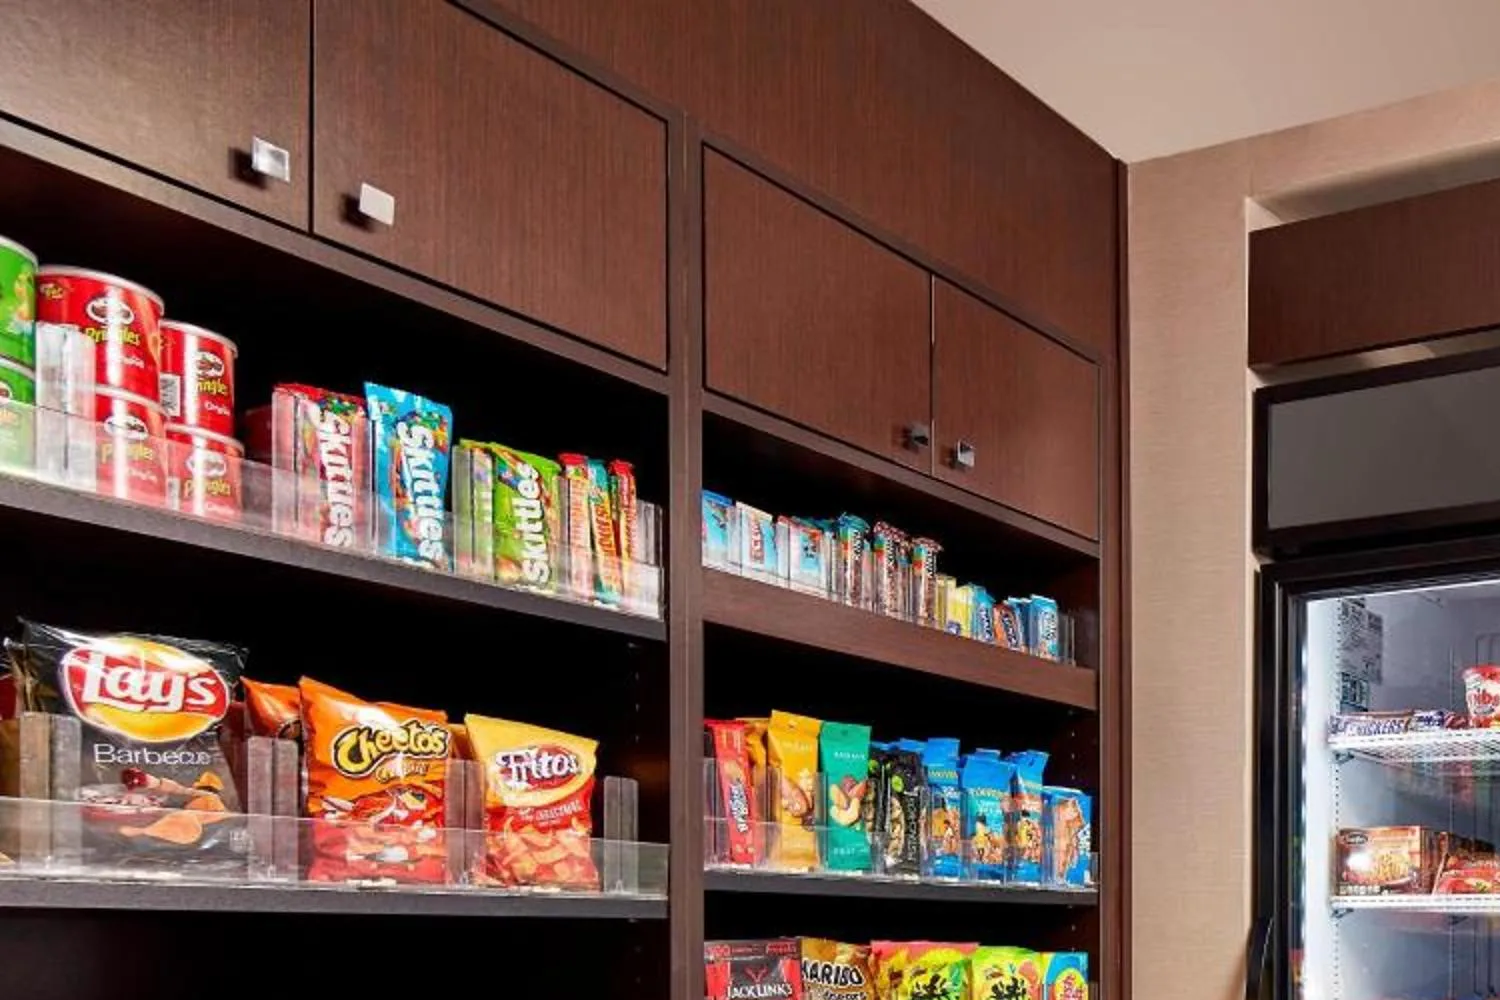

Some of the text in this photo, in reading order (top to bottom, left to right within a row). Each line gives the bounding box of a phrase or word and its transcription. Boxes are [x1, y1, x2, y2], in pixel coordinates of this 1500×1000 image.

[319, 409, 352, 548] Skittles
[396, 420, 445, 562] Skittles
[511, 463, 550, 584] Skittles
[66, 648, 219, 713] Lay's
[93, 742, 213, 767] Barbecue
[332, 719, 451, 777] Cheetos
[495, 746, 582, 791] Fritos
[801, 958, 864, 987] HARIBO
